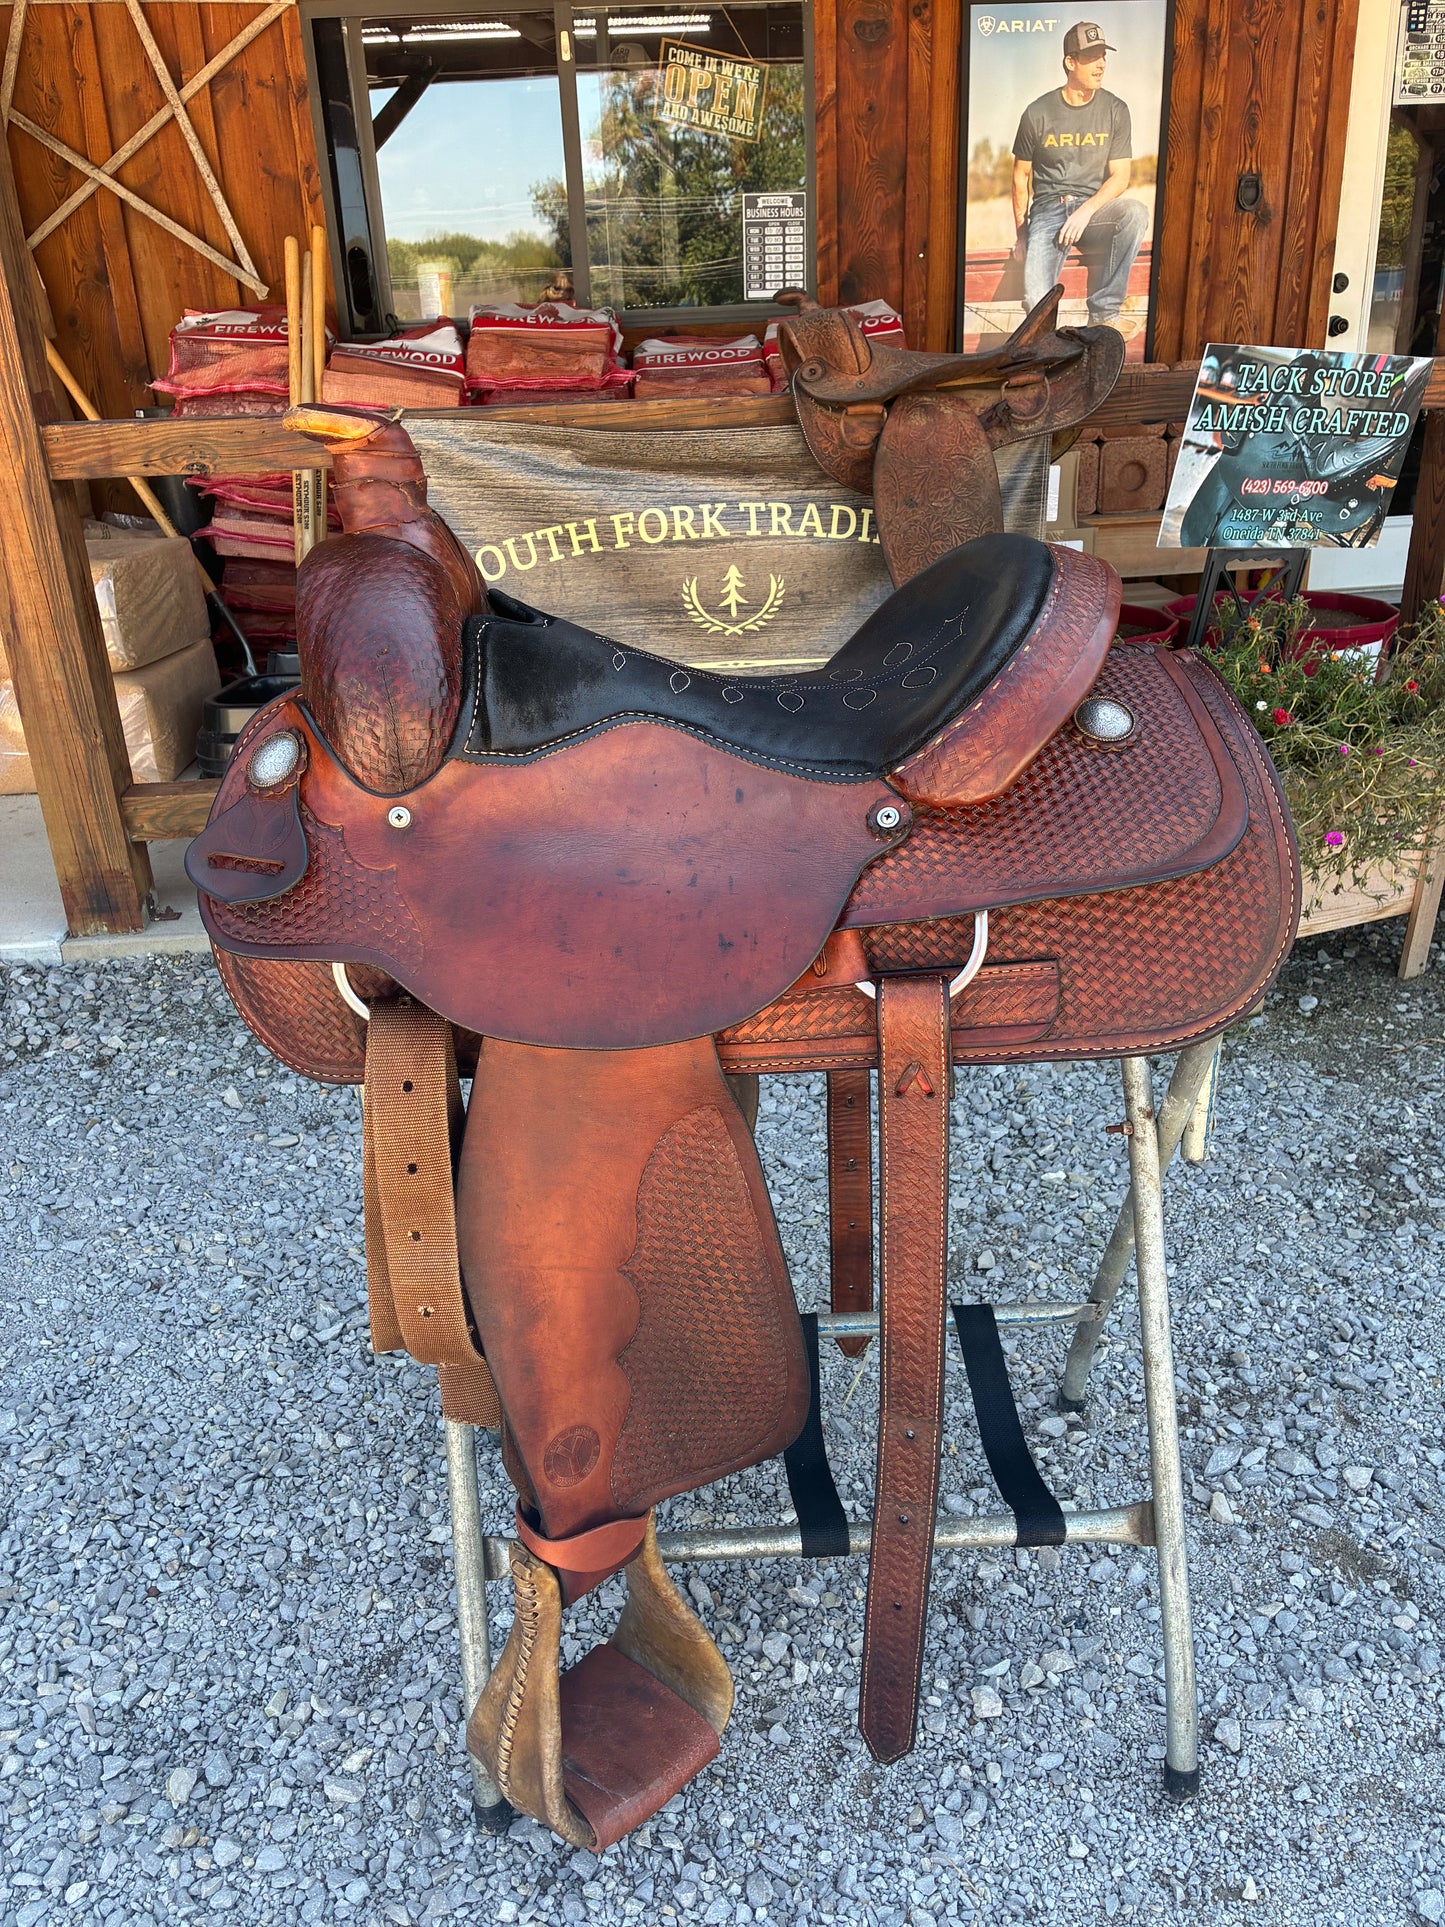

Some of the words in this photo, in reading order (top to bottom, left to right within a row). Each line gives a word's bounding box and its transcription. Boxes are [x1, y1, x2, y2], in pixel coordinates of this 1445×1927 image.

[996, 19, 1057, 33] ARIAT
[668, 47, 702, 68] COME
[704, 56, 718, 73] IN
[721, 60, 760, 83] WE'RE
[664, 63, 759, 121] OPEN
[662, 102, 688, 120] AND
[691, 108, 754, 136] AWESOME
[1043, 133, 1109, 148] ARIAT
[761, 197, 789, 205] WELCOME
[746, 208, 779, 219] BUSINESS
[780, 207, 804, 217] HOURS
[214, 325, 289, 335] FIREWO
[347, 348, 457, 365] FIREWOOD
[645, 349, 751, 364] FIREWOOD
[1237, 364, 1307, 395] TACK
[1309, 368, 1395, 398] STORE
[1193, 403, 1289, 433] AMISH
[1292, 406, 1410, 437] CRAFTED
[1241, 477, 1272, 495] (423)
[1272, 479, 1329, 495] 569-6700
[1231, 509, 1259, 521] 1487
[1262, 508, 1276, 521] W
[1277, 508, 1298, 522] 3rd
[1299, 509, 1323, 522] Ave
[1223, 526, 1264, 540] Oneida
[1268, 527, 1286, 540] TN
[1287, 528, 1320, 540] 37841
[475, 518, 603, 582] OUTH
[610, 502, 731, 549] FORK
[738, 502, 881, 544] TRADI
